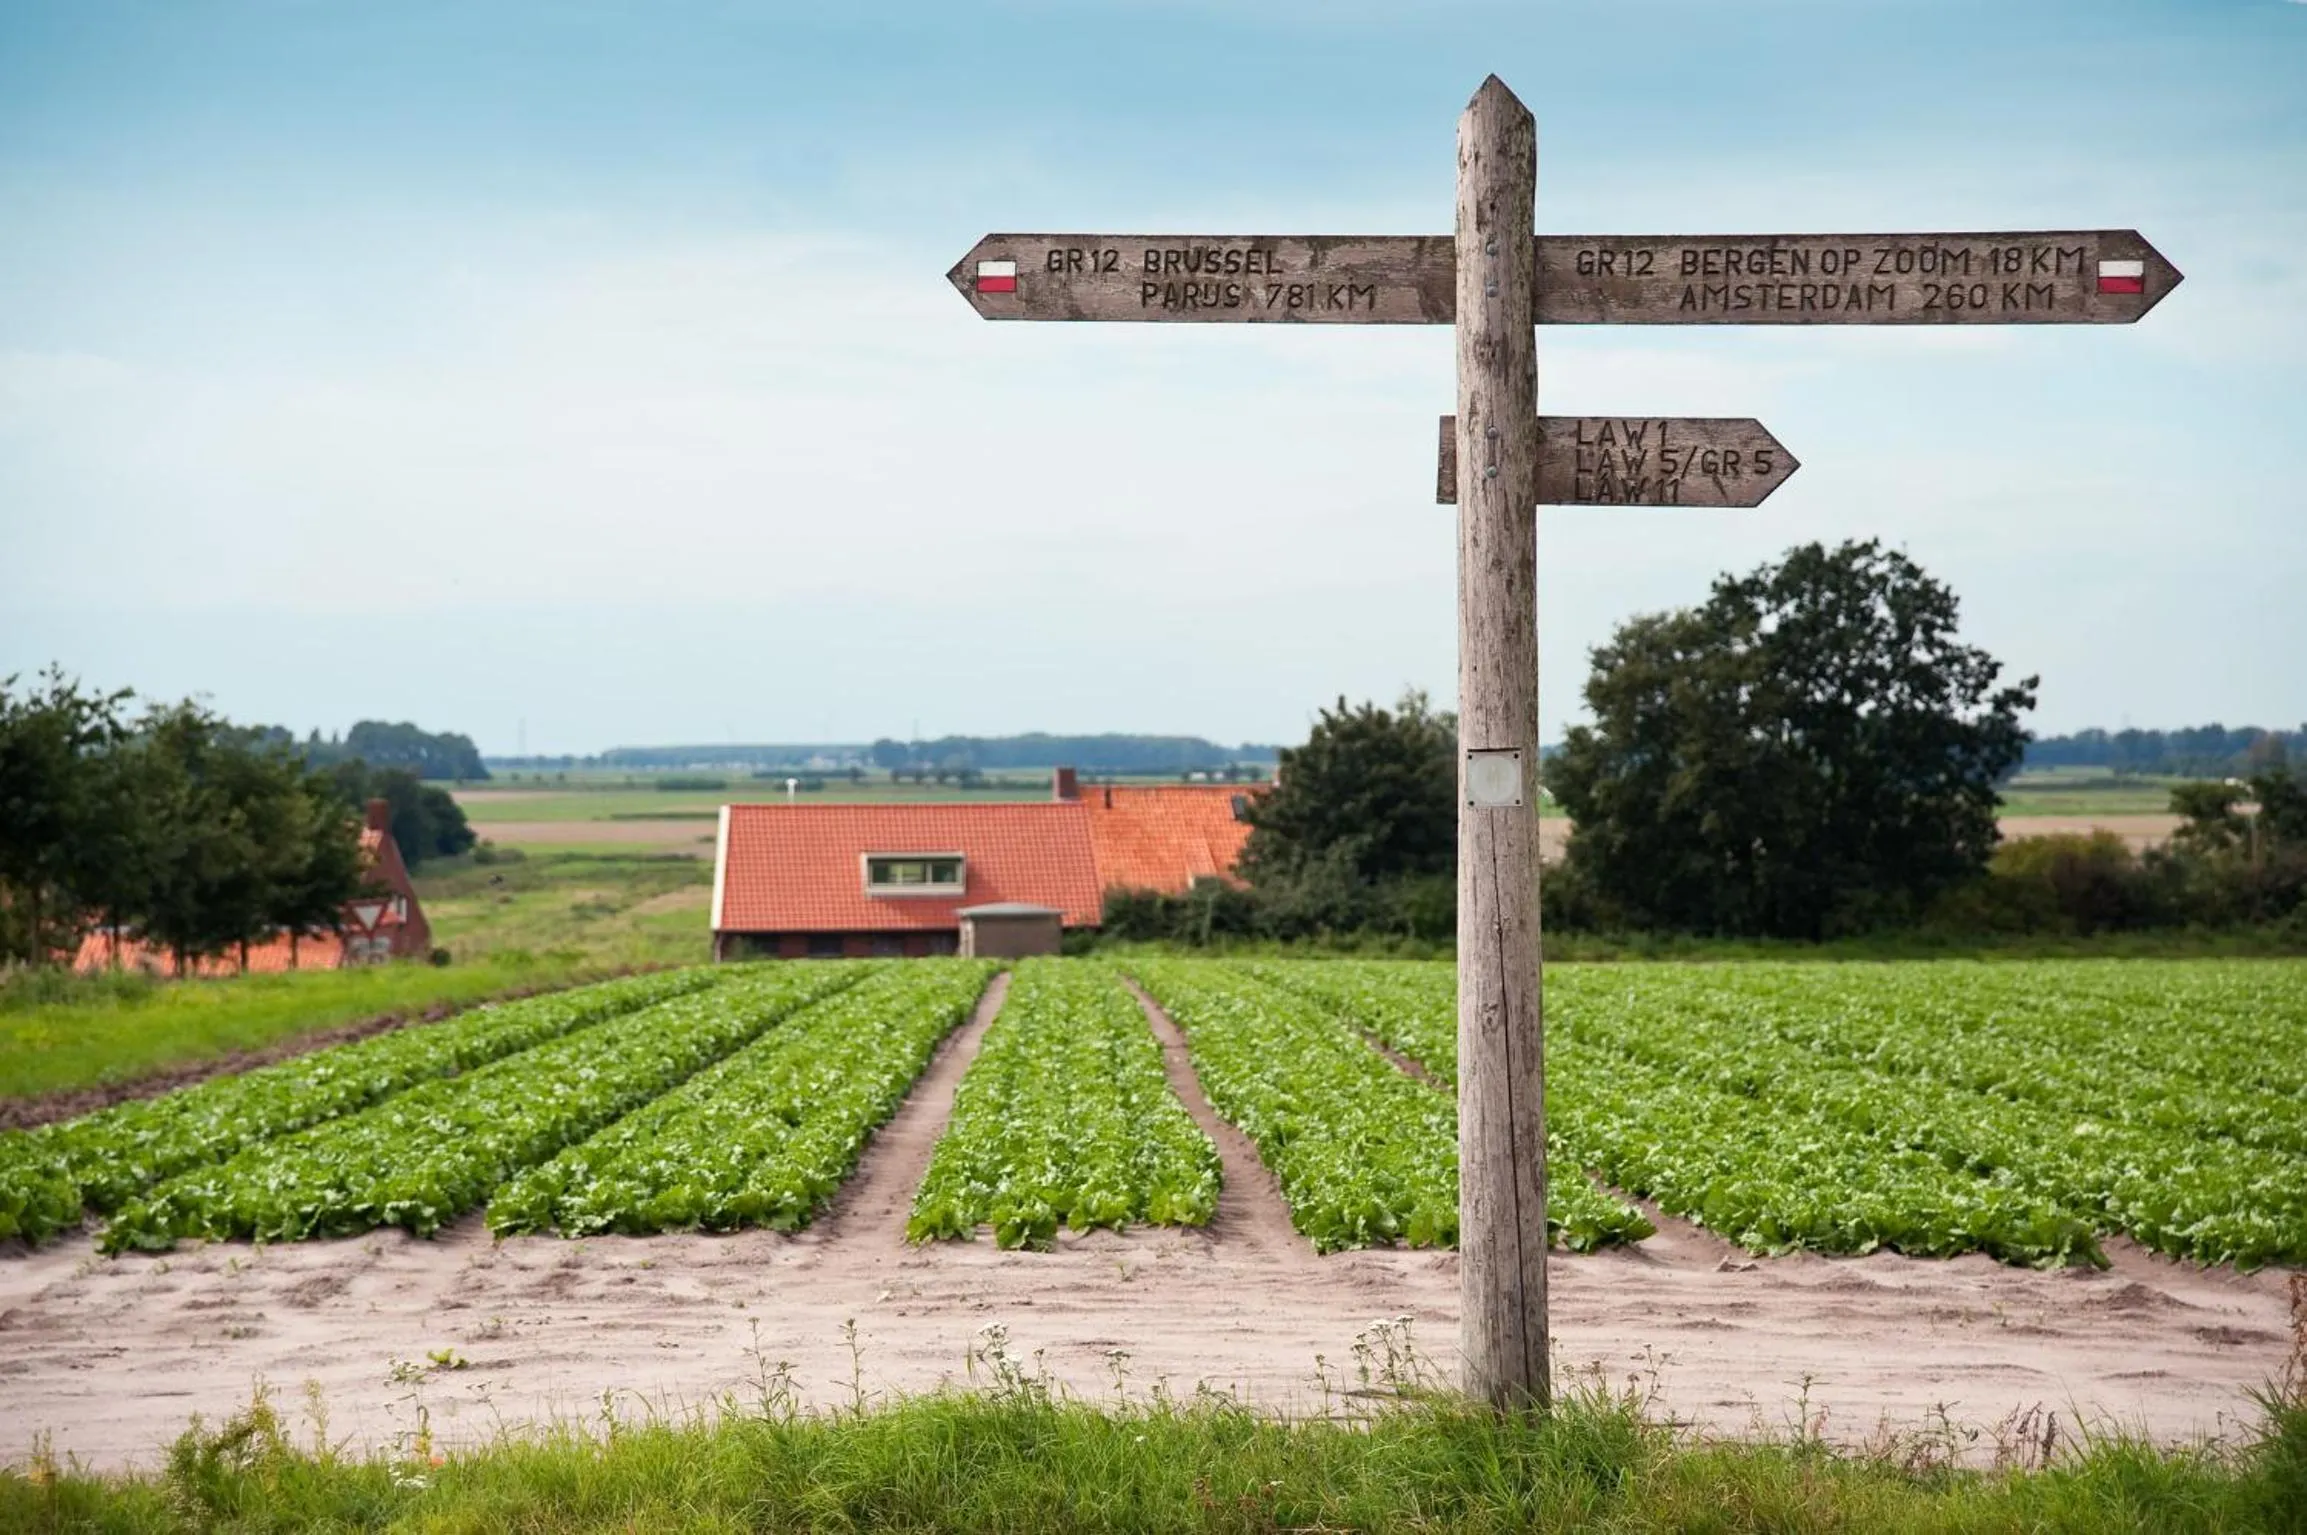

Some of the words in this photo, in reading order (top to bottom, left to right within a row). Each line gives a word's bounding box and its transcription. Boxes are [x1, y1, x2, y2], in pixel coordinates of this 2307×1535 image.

[1144, 249, 1284, 275] BRUSSEL
[1681, 248, 1809, 276] BERGEN
[1821, 248, 1861, 276] OP
[1873, 247, 1970, 276] ZOOM
[1990, 247, 2022, 275] 18
[2032, 246, 2085, 275] KM
[1266, 283, 1315, 311] 781
[1328, 283, 1376, 311] KM
[1679, 284, 1896, 311] AMSTERDAM
[1923, 283, 1989, 309] 260
[2001, 282, 2053, 310] KM
[1576, 420, 1648, 447] LAW
[1658, 421, 1668, 447] 1
[1576, 449, 1648, 475] LAW
[1755, 451, 1773, 475] 5
[1575, 475, 1648, 502] LAW
[1655, 478, 1680, 502] 11
